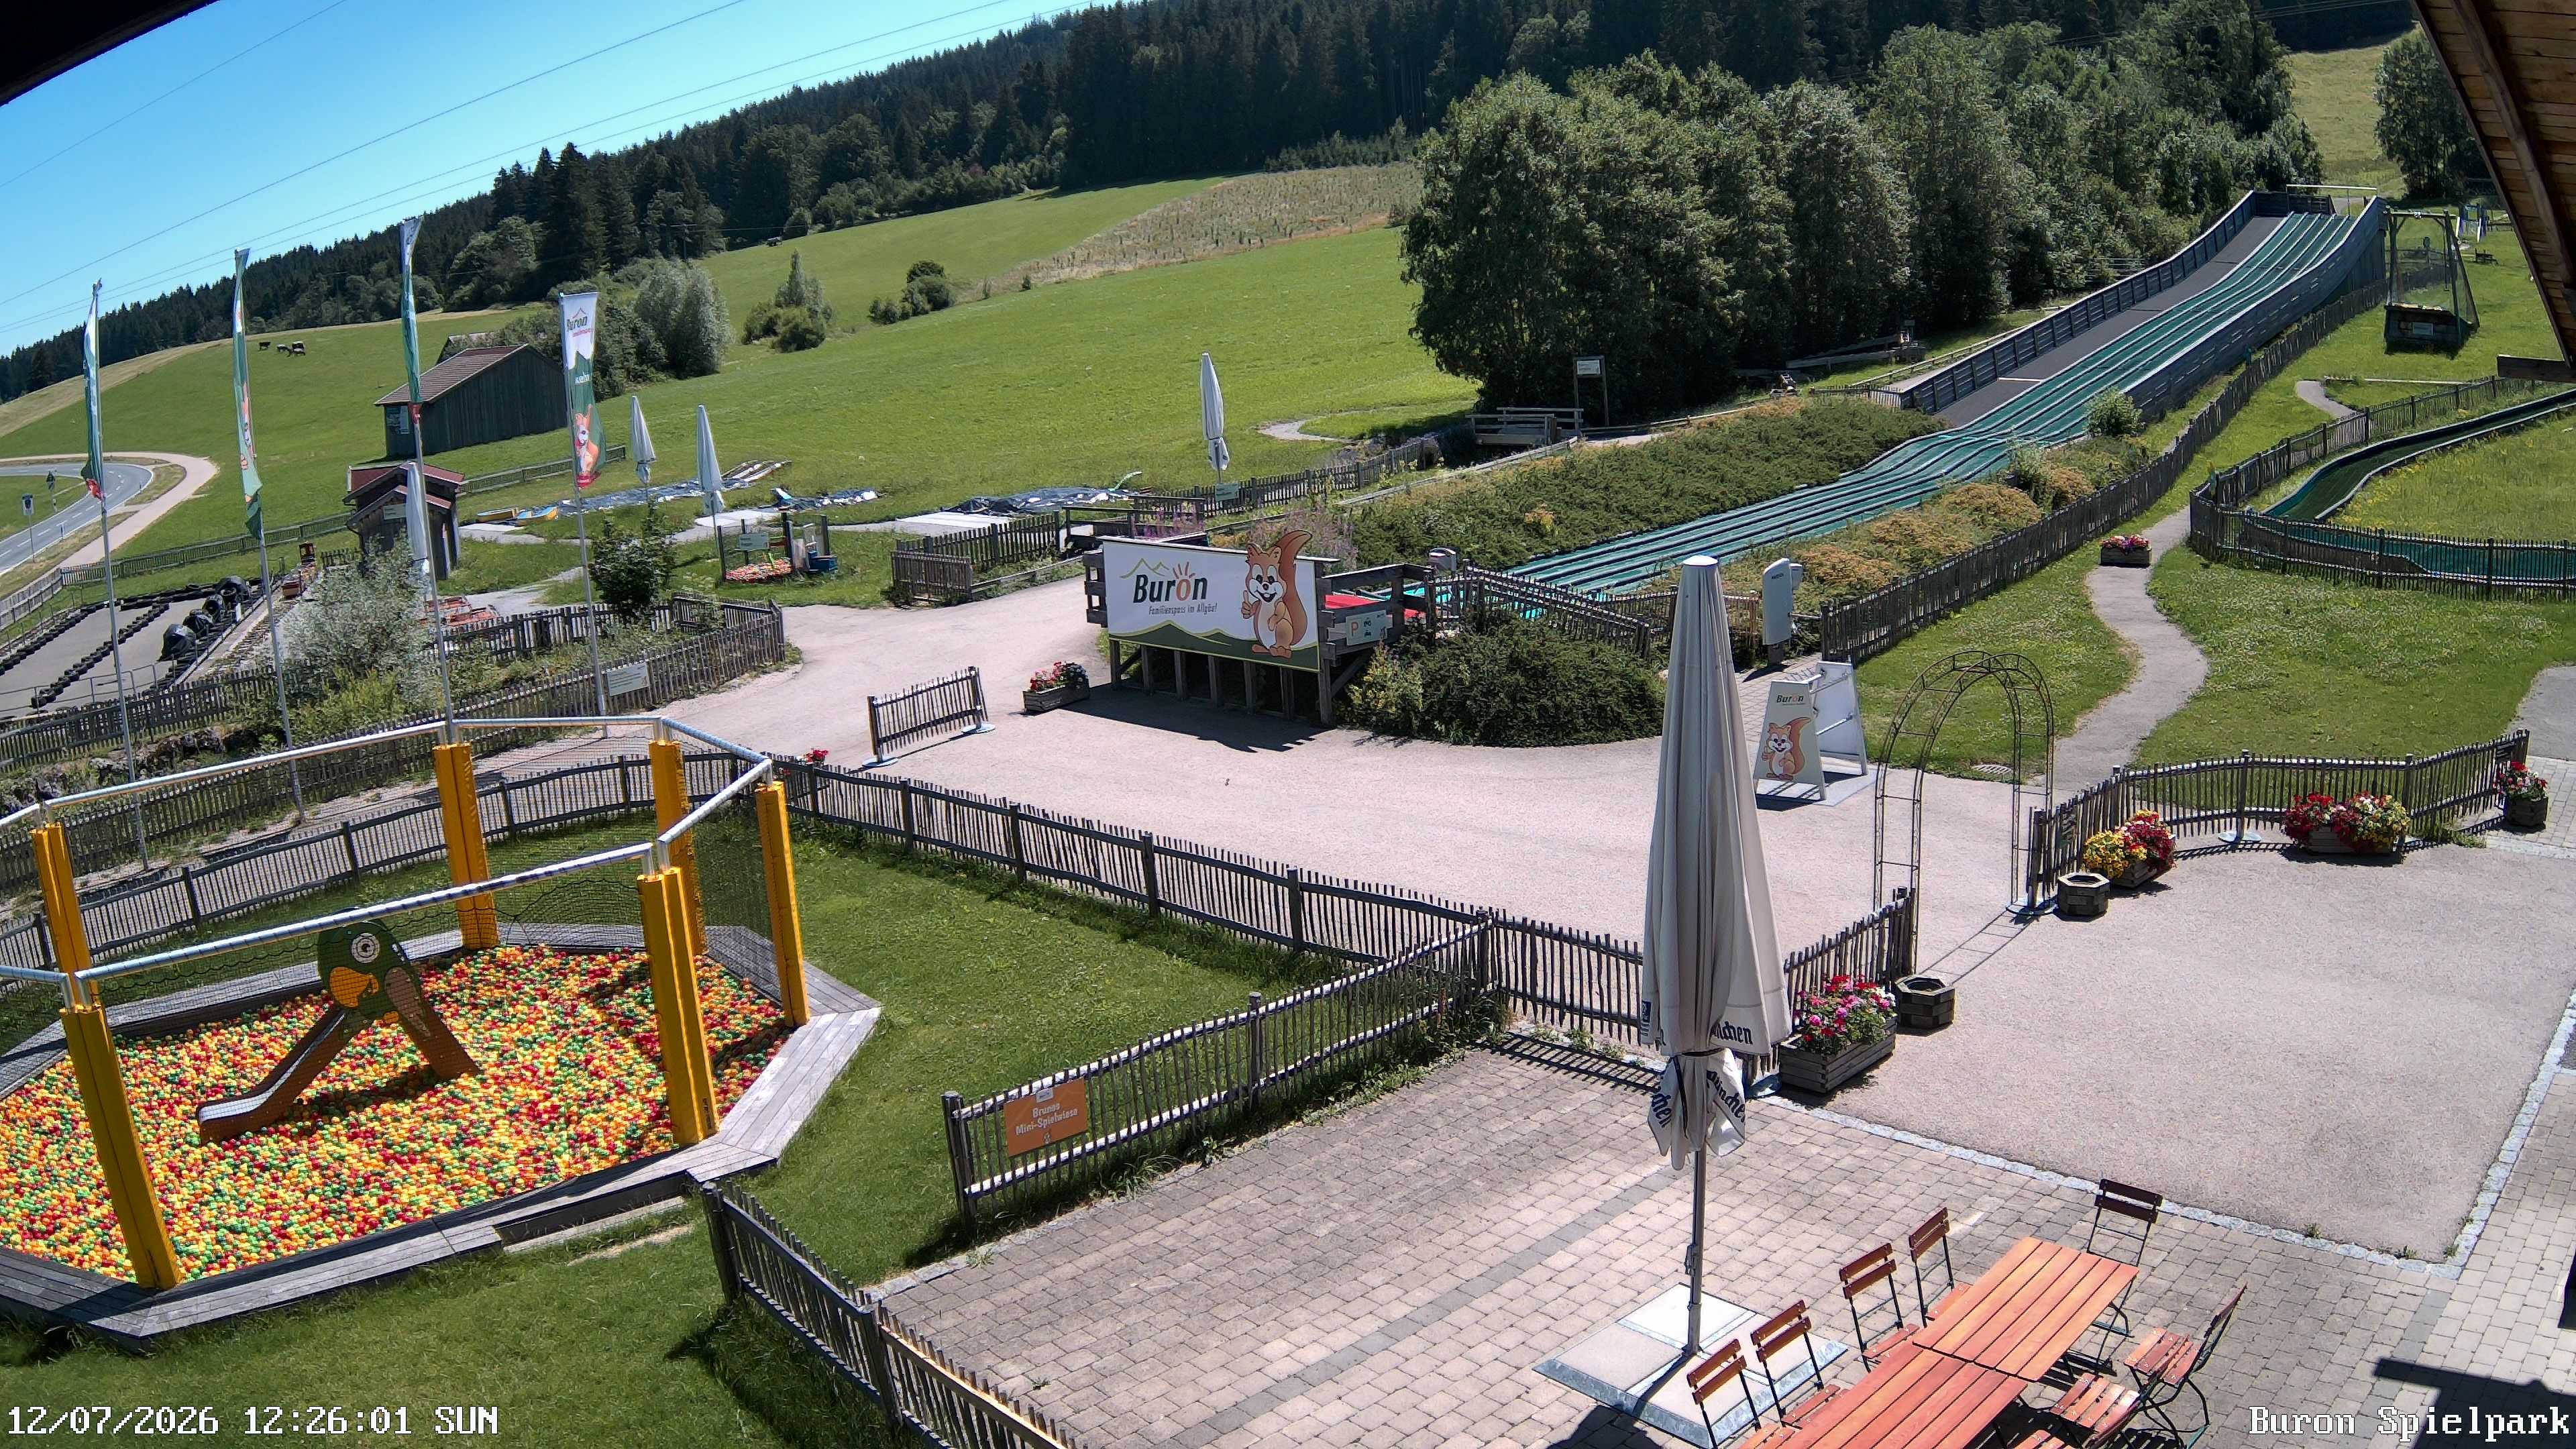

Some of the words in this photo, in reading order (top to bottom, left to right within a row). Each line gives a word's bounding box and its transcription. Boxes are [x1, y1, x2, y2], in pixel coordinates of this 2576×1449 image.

[1133, 574, 1208, 603] Buron
[1351, 621, 1359, 637] P
[1776, 694, 1804, 703] Buron
